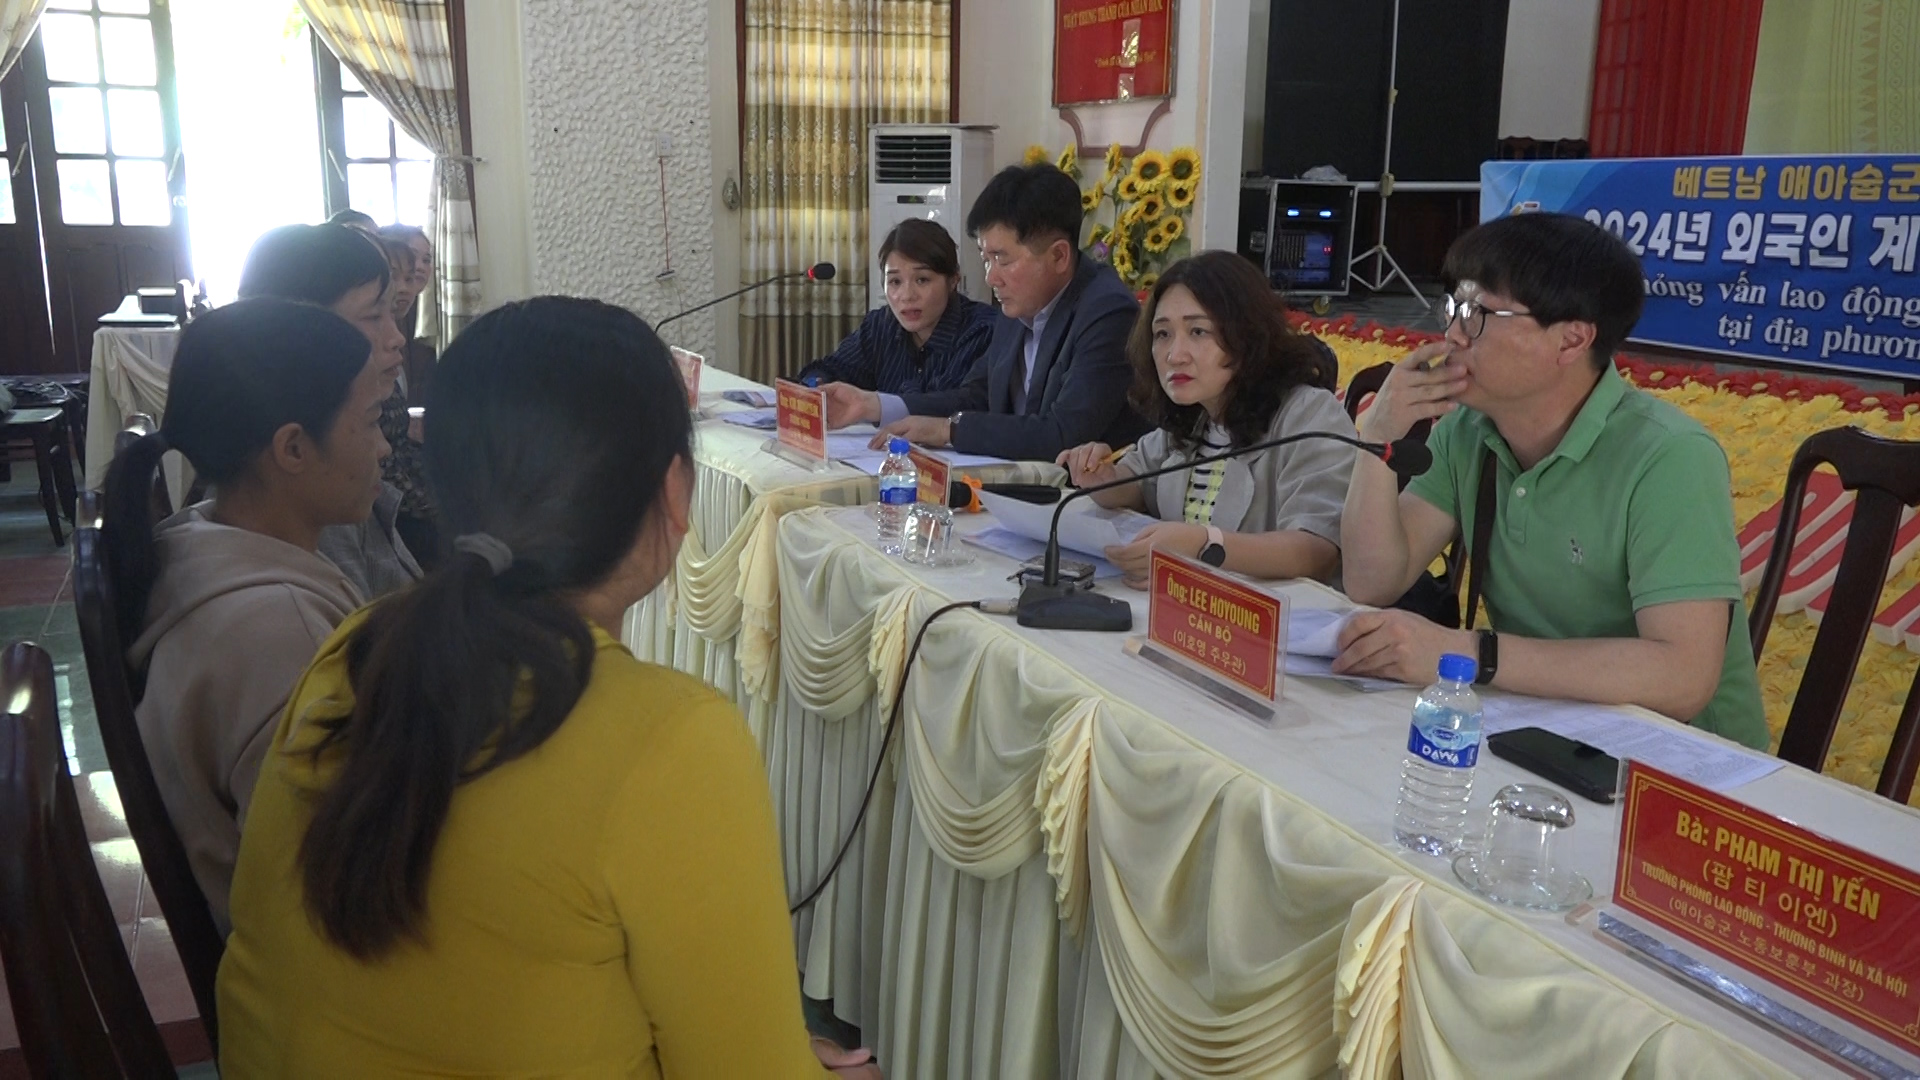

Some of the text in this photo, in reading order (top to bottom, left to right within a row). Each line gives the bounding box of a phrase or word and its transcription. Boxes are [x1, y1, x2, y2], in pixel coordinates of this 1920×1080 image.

[1673, 165, 1766, 200] 베트남
[1584, 209, 1712, 261] 024년
[1721, 211, 1852, 269] 외국인
[1718, 270, 1767, 304] vấn
[1780, 281, 1826, 310] lao
[1842, 286, 1920, 327] động
[1718, 314, 1753, 346] tại
[1764, 317, 1809, 352] địa
[1188, 612, 1232, 646] CÁN BỘ
[1190, 585, 1208, 612] LEE
[1210, 595, 1260, 634] HOYOUNG
[1676, 810, 1880, 921] Bà: PHẠM THỊ YẾN
[1714, 895, 1733, 915] LAO
[1818, 943, 1847, 968] BINH
[1744, 877, 1766, 906] 티
[1778, 892, 1837, 938] 이엔)
